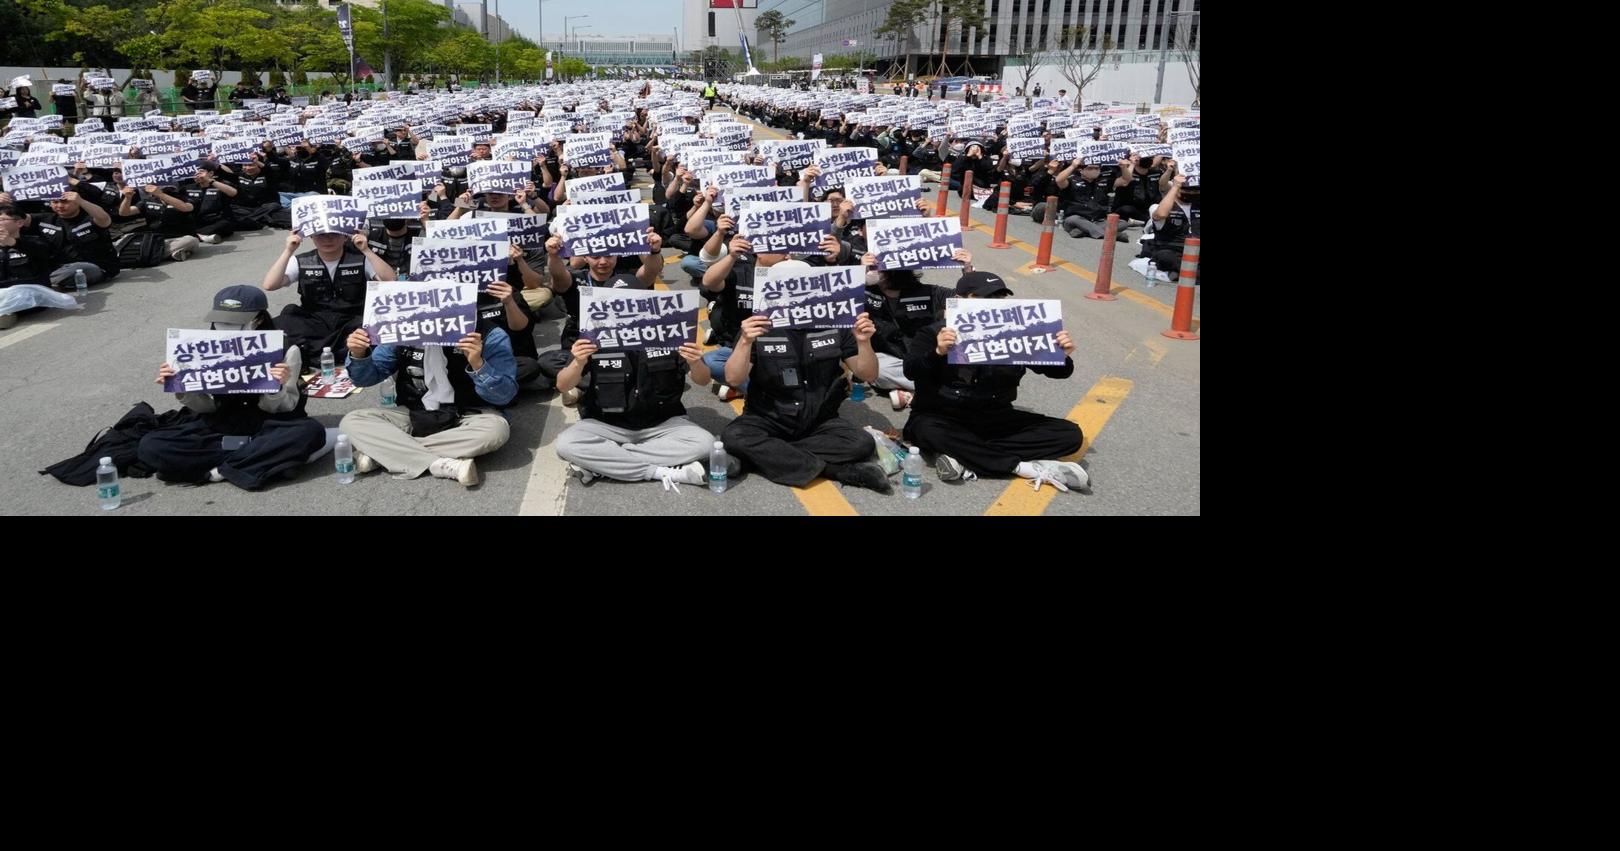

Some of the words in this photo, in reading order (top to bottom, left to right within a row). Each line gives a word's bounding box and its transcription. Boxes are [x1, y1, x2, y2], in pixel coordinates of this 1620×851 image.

[215, 142, 247, 153] 상한폐지
[429, 142, 466, 155] 상한폐지
[566, 142, 603, 157] 상한폐지
[776, 141, 821, 157] 상한폐지
[171, 154, 192, 165] 폐지
[436, 154, 471, 167] 현하자
[691, 154, 735, 167] 상한폐지
[782, 156, 814, 170] 실현하
[818, 149, 870, 168] 상한폐지
[8, 167, 60, 185] 상한폐지
[123, 161, 164, 174] 상한폐지
[414, 163, 435, 174] 폐지
[470, 163, 513, 178] 상한폐지
[825, 167, 874, 185] 실현하자
[127, 173, 170, 186] 실현하자
[570, 175, 617, 192] 상한폐지
[716, 168, 768, 185] 상한폐지
[13, 183, 67, 200] 실현하자
[357, 182, 413, 199] 상한폐지
[850, 178, 911, 200] 상한폐지
[857, 197, 917, 218] 실현하자
[507, 215, 538, 229] 폐지
[563, 206, 637, 232] 상한폐지
[745, 205, 820, 228] 상한폐지
[511, 233, 544, 245] 하자
[873, 219, 948, 244] 상한폐지
[570, 229, 647, 255] 실현하자
[751, 229, 825, 254] 실현하자
[418, 243, 496, 265] 상한폐지
[882, 245, 956, 269] 실현하자
[761, 269, 853, 301] 상한폐지
[371, 286, 462, 314] 상한폐지
[587, 293, 684, 320] 상한폐지
[768, 297, 864, 327] 실현하자
[954, 303, 1047, 333] 상한폐지
[377, 315, 475, 344] 실현하자
[596, 321, 695, 348] 실현하자
[173, 332, 268, 363] 상한폐지
[764, 344, 787, 353] 투쟁
[812, 339, 835, 349] SELU
[964, 333, 1059, 362] 실현하자
[647, 350, 670, 358] SELU
[598, 359, 622, 368] 투쟁
[181, 362, 273, 391] 실현하자
